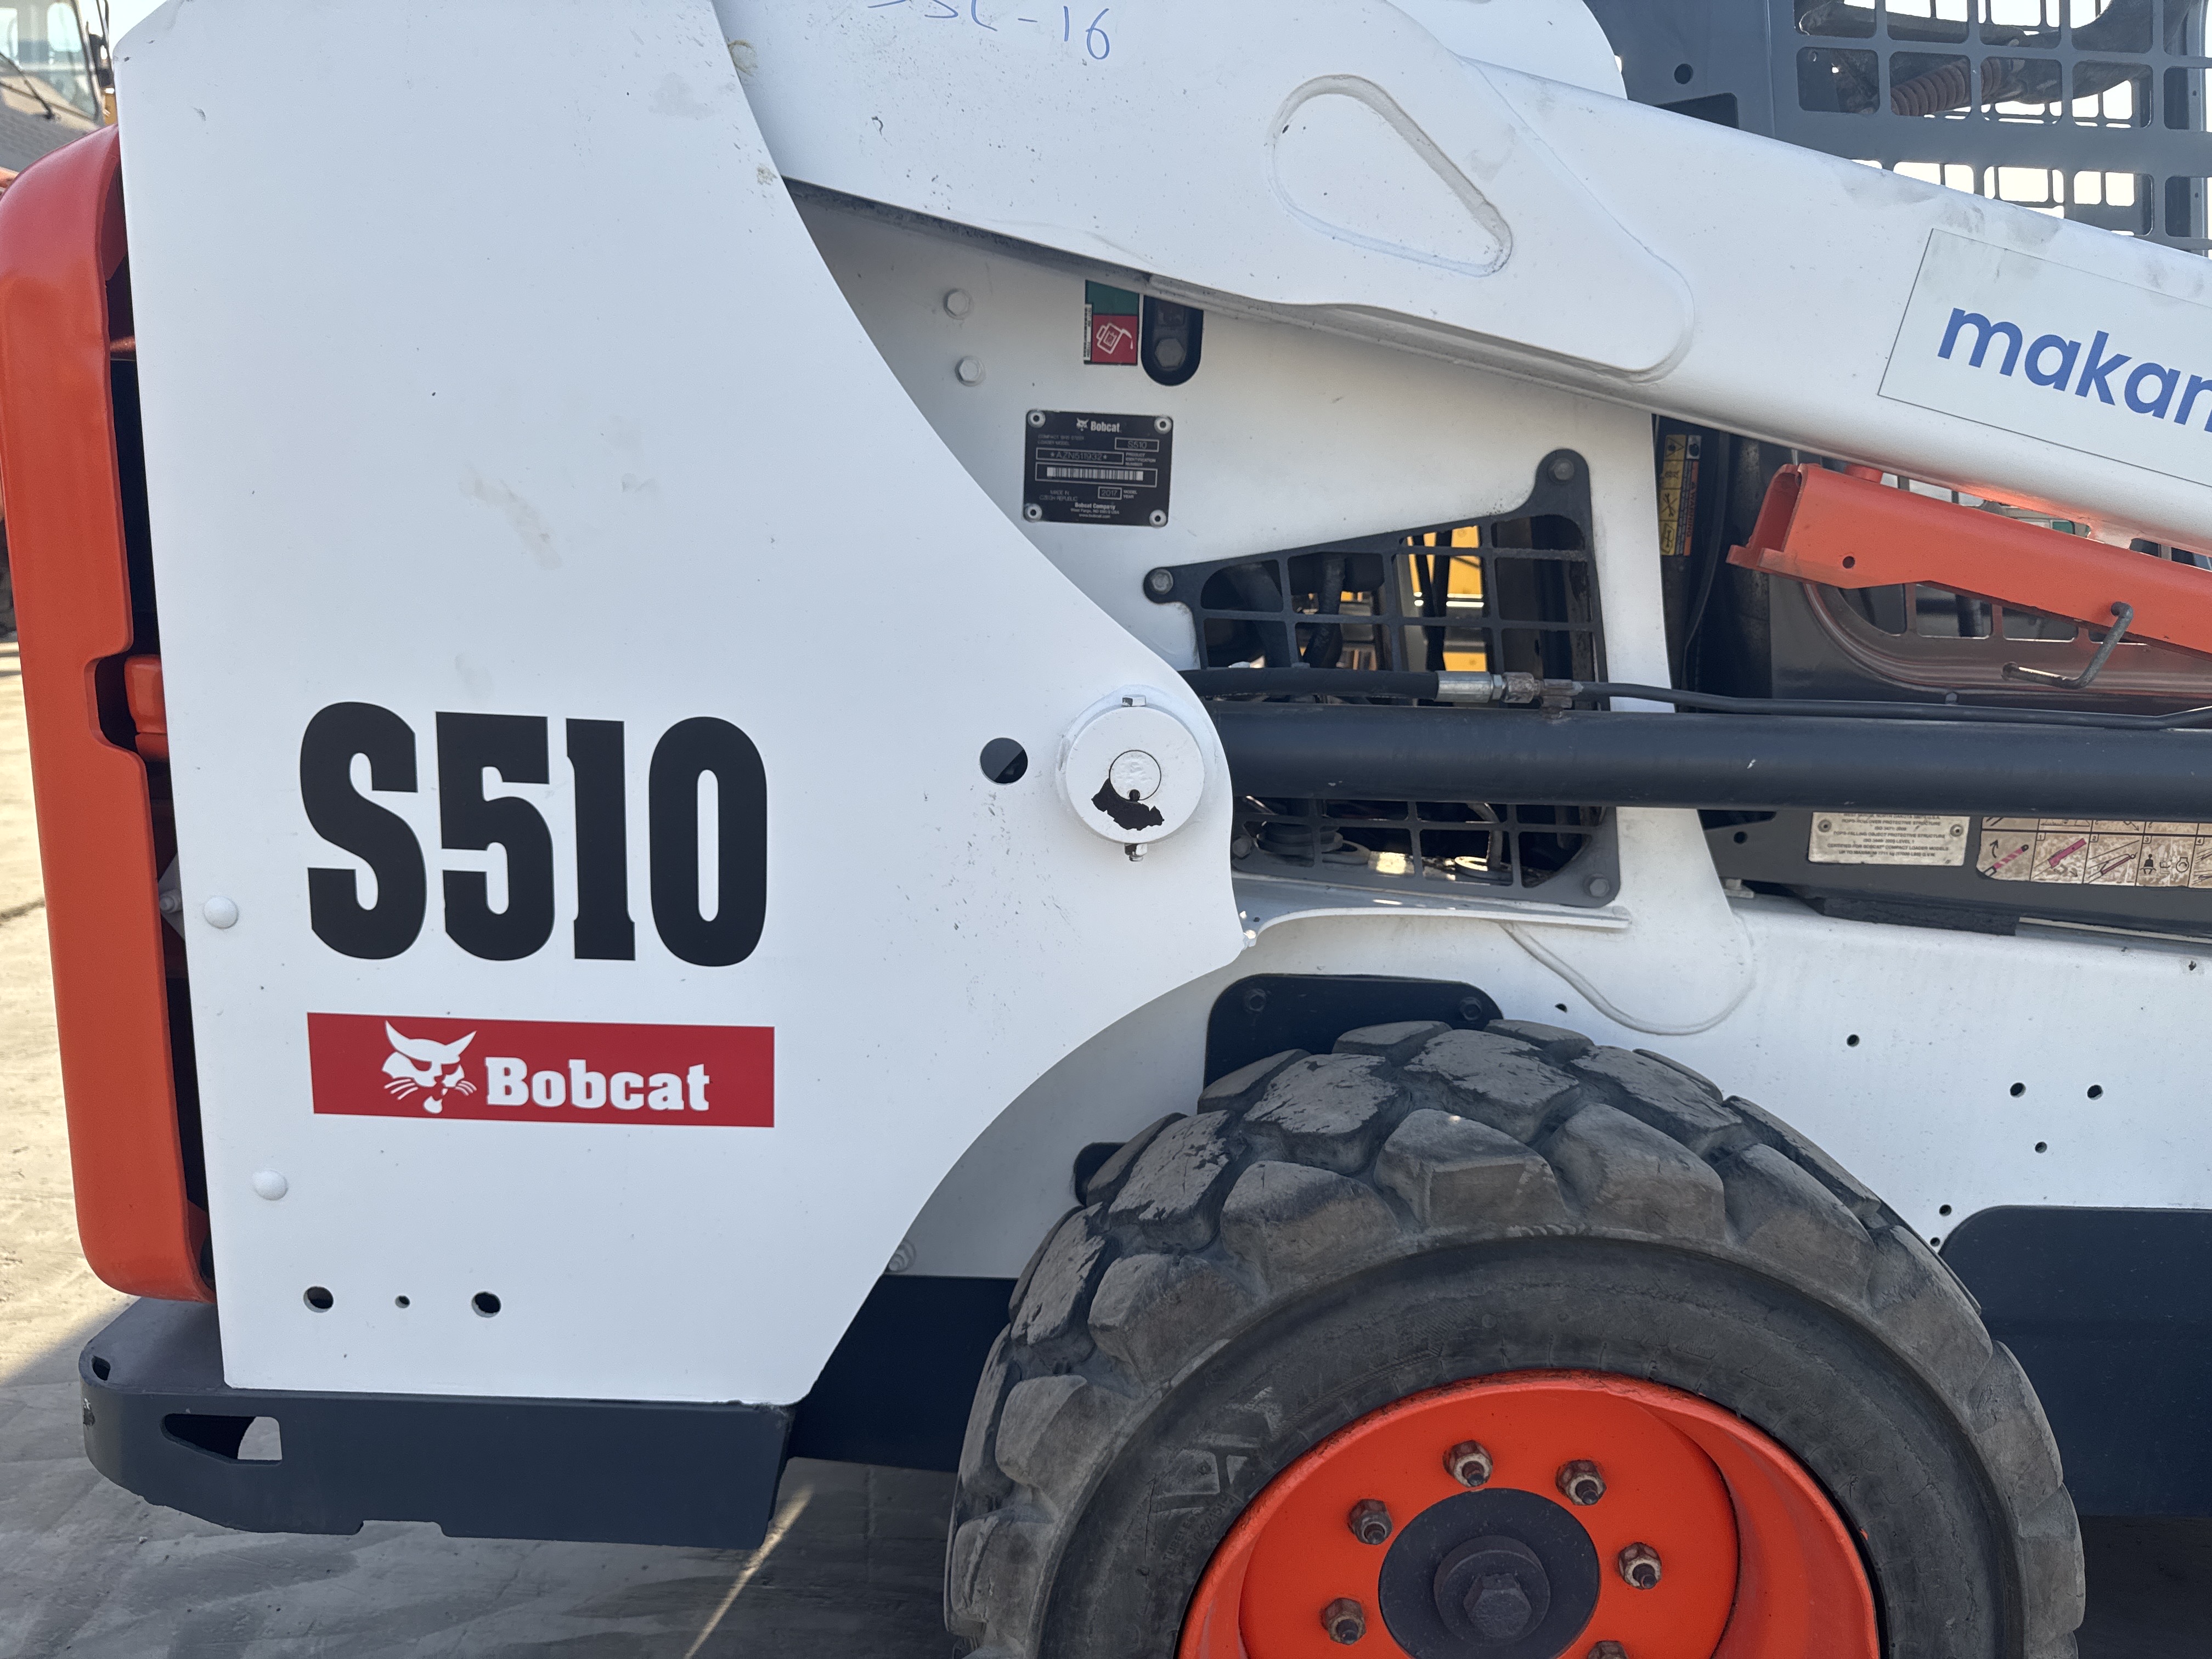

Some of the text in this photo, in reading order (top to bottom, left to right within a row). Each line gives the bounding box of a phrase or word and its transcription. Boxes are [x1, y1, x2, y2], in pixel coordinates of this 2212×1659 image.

[1090, 421, 1120, 433] Bobcat
[1127, 440, 1147, 449] S510
[300, 701, 768, 967] S510
[484, 1056, 710, 1111] Bobcat
